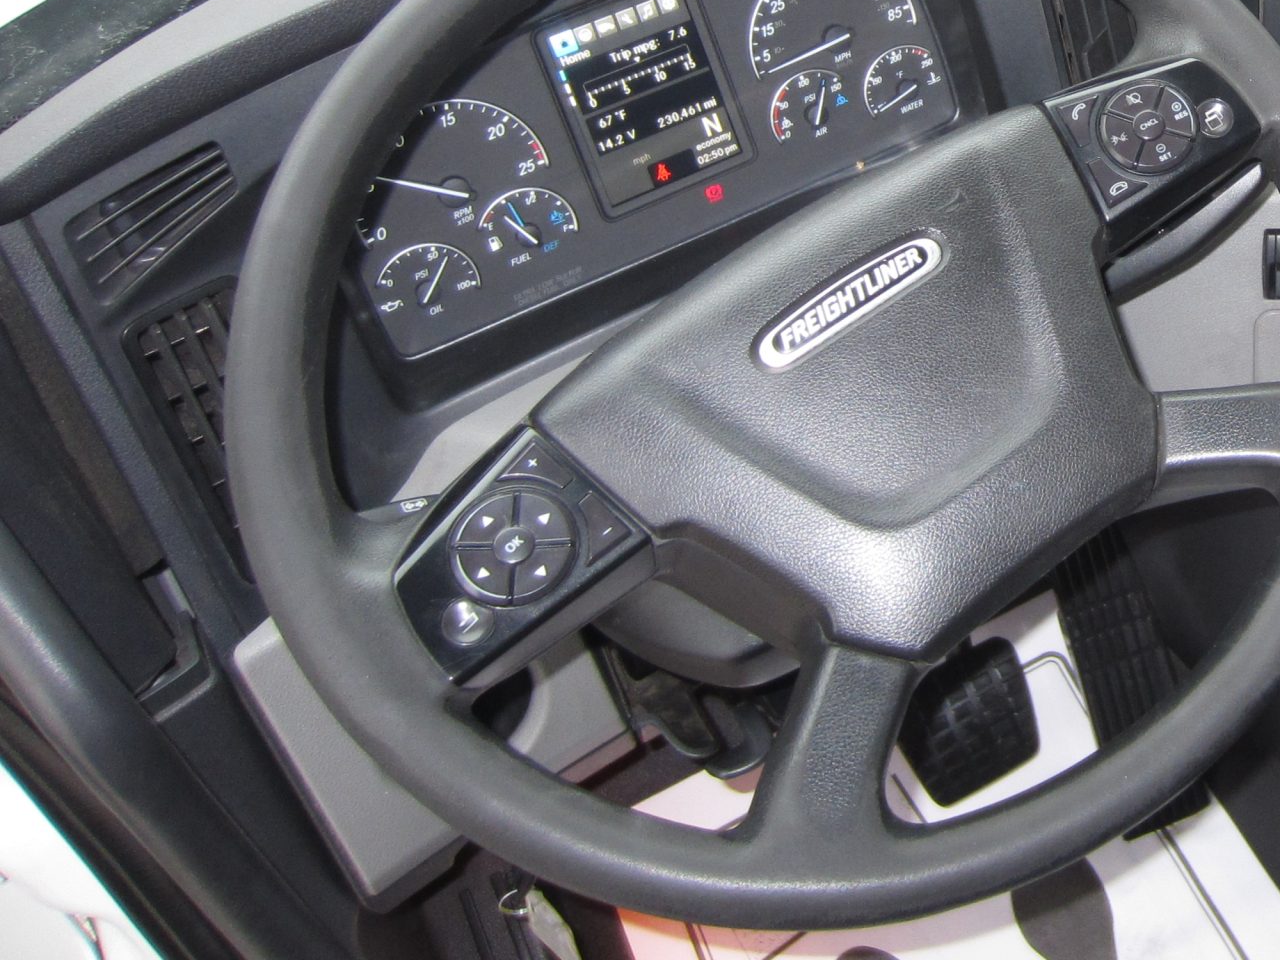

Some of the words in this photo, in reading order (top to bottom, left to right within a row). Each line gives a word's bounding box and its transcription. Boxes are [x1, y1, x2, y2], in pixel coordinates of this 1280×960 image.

[887, 6, 903, 22] 85
[760, 23, 775, 38] 15
[609, 47, 633, 63] Trip
[633, 37, 661, 55] mpg:
[667, 26, 688, 41] 7.6
[559, 48, 591, 67] Home
[762, 48, 772, 63] 5
[834, 51, 852, 64] MPH
[889, 53, 902, 65] 200
[920, 58, 934, 69] 250
[589, 97, 598, 108] 0
[623, 84, 631, 95] 5
[654, 70, 667, 83] 10
[683, 59, 697, 72] 15
[797, 78, 810, 89] 100
[830, 82, 842, 93] 150
[871, 75, 883, 86] 150
[779, 101, 789, 110] 50
[804, 93, 816, 104] PSI
[657, 103, 703, 128] 230,461
[703, 96, 718, 110] mi
[900, 99, 924, 114] WATER
[440, 112, 456, 128] 15
[599, 115, 613, 129] 67
[1174, 110, 1189, 121] RES
[702, 113, 723, 137] N
[1139, 118, 1159, 131] CNCL
[487, 123, 506, 141] 20
[785, 130, 791, 139] 0
[815, 126, 828, 138] AIR
[599, 135, 625, 152] 14.2
[627, 129, 637, 140] V
[696, 131, 733, 151] economy
[632, 153, 651, 165] mph
[697, 147, 725, 165] 02:50
[724, 143, 739, 157] pm
[1158, 152, 1172, 162] SET
[518, 159, 536, 176] 25
[453, 206, 473, 220] RPM
[457, 213, 475, 227] x100
[377, 227, 387, 241] 0
[487, 223, 494, 231] E
[543, 240, 560, 253] DEF
[427, 251, 439, 262] 50
[511, 253, 532, 267] FUEL
[414, 268, 429, 281] PSI
[456, 280, 471, 291] 100
[780, 247, 922, 352] FREIGHTLINER
[429, 304, 445, 316] OIL
[504, 535, 524, 553] OK
